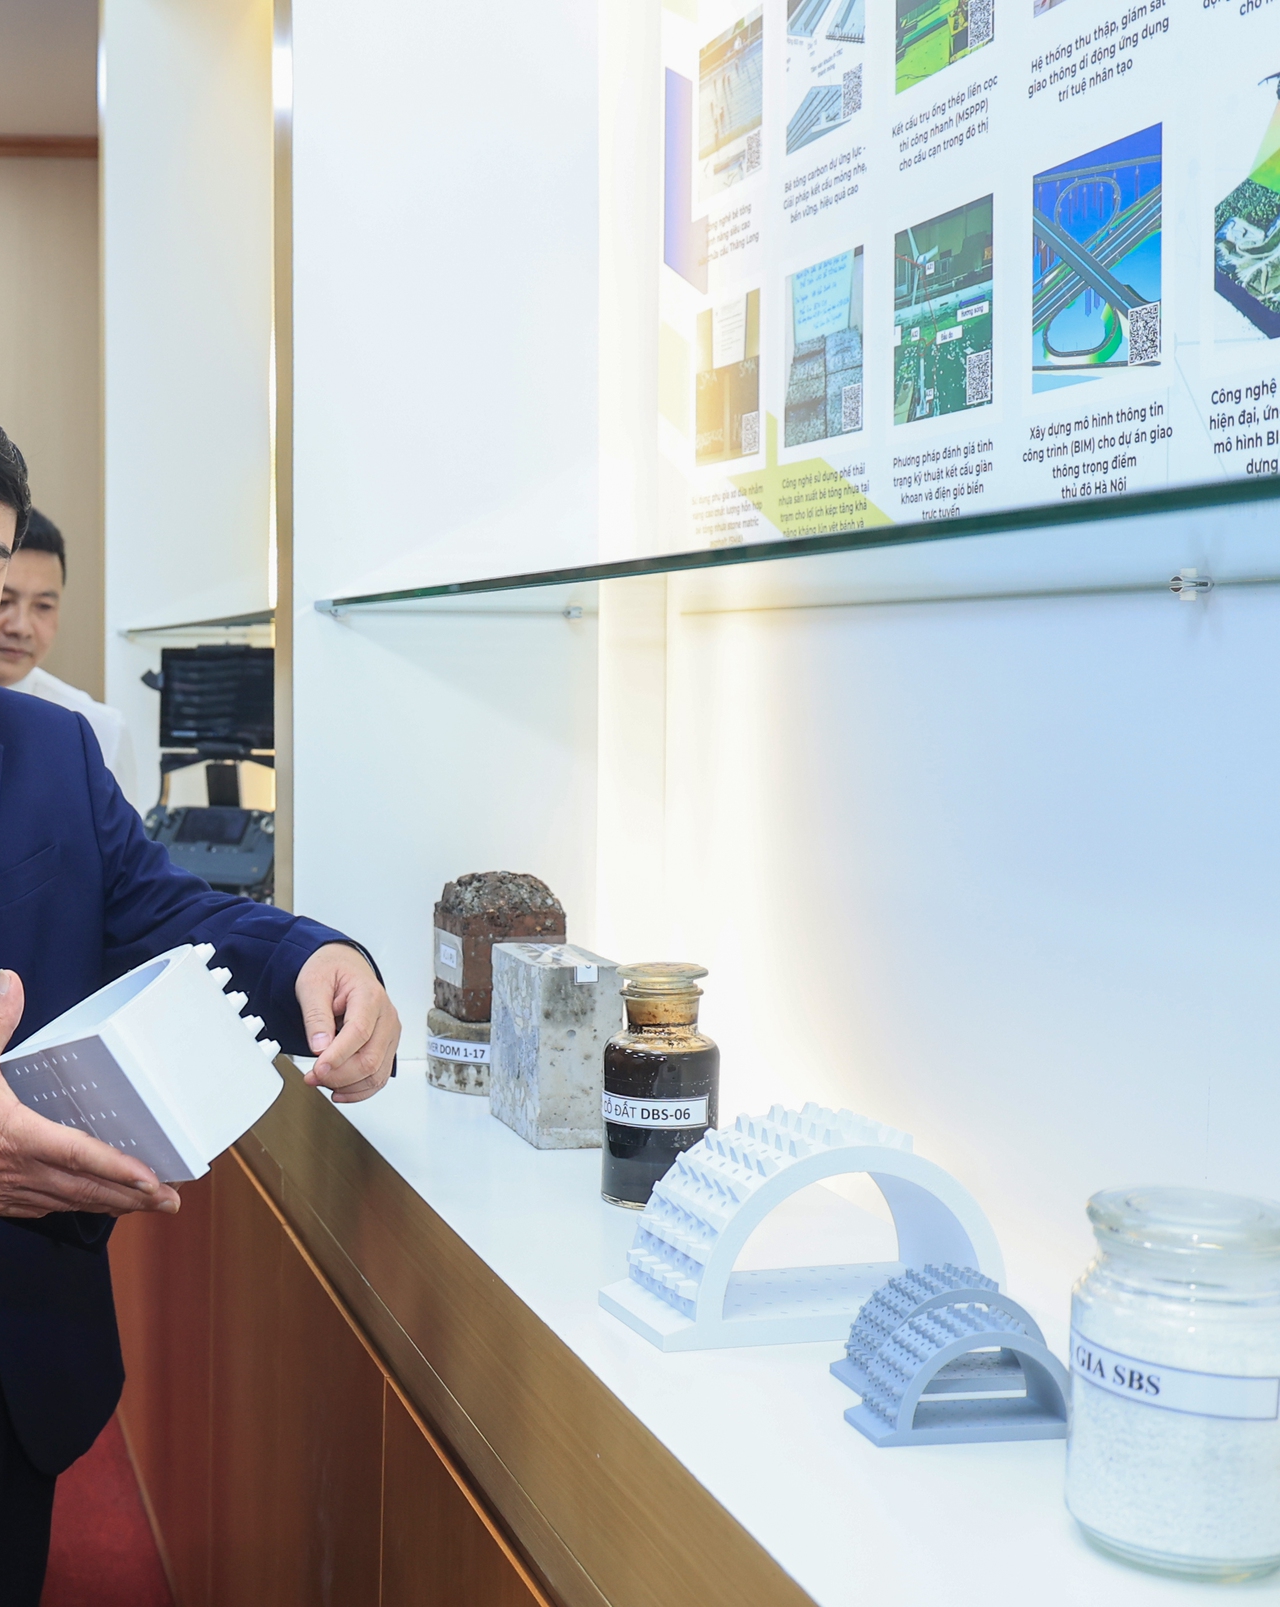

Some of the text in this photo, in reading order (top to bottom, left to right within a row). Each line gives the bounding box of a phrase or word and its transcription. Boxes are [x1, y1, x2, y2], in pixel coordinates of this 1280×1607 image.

[1031, 56, 1043, 73] Hệ
[1045, 44, 1072, 66] thống
[1075, 34, 1091, 50] thu
[1094, 20, 1119, 40] thập,
[1121, 6, 1147, 30] giám
[1028, 17, 1169, 98] giao thông di động ứng dụng
[1058, 58, 1133, 102] trí tuệ nhân tạo
[892, 121, 904, 138] Kết
[905, 115, 918, 131] cấu
[919, 111, 930, 124] trụ
[932, 102, 946, 117] ống
[948, 91, 965, 109] thép
[984, 75, 998, 91] cọc
[899, 138, 909, 152] thi
[911, 133, 928, 148] công
[930, 116, 953, 138] nhanh
[899, 155, 912, 171] cho
[928, 144, 941, 158] cạn
[943, 132, 964, 150] trong
[966, 126, 976, 140] đô
[978, 117, 988, 134] thị
[1211, 378, 1276, 405] Công nghệ
[1029, 401, 1163, 441] Xây dựng mô hình thông tin
[1209, 404, 1280, 432] hiện đại, ứn
[893, 438, 993, 468] Phương pháp đánh giá tình
[1022, 425, 1173, 462] công trình (BIM) cho dự án giao
[1214, 430, 1280, 454] mô hình BI
[893, 460, 993, 489] trạng kỹ thuật kết cấu giàn
[1052, 452, 1137, 479] thông trọng điểm
[1246, 458, 1278, 477] dựng
[901, 492, 923, 505] khoan
[924, 489, 933, 501] và
[935, 486, 951, 501] điện
[953, 483, 965, 500] gió
[1061, 476, 1127, 499] thủ đô Hà Nội
[440, 1044, 460, 1056] DOM
[463, 1048, 485, 1059] 1-17
[614, 1101, 637, 1118] ĐẤT
[641, 1108, 691, 1120] DBS-06
[1076, 1345, 1161, 1396] GIA SBS
